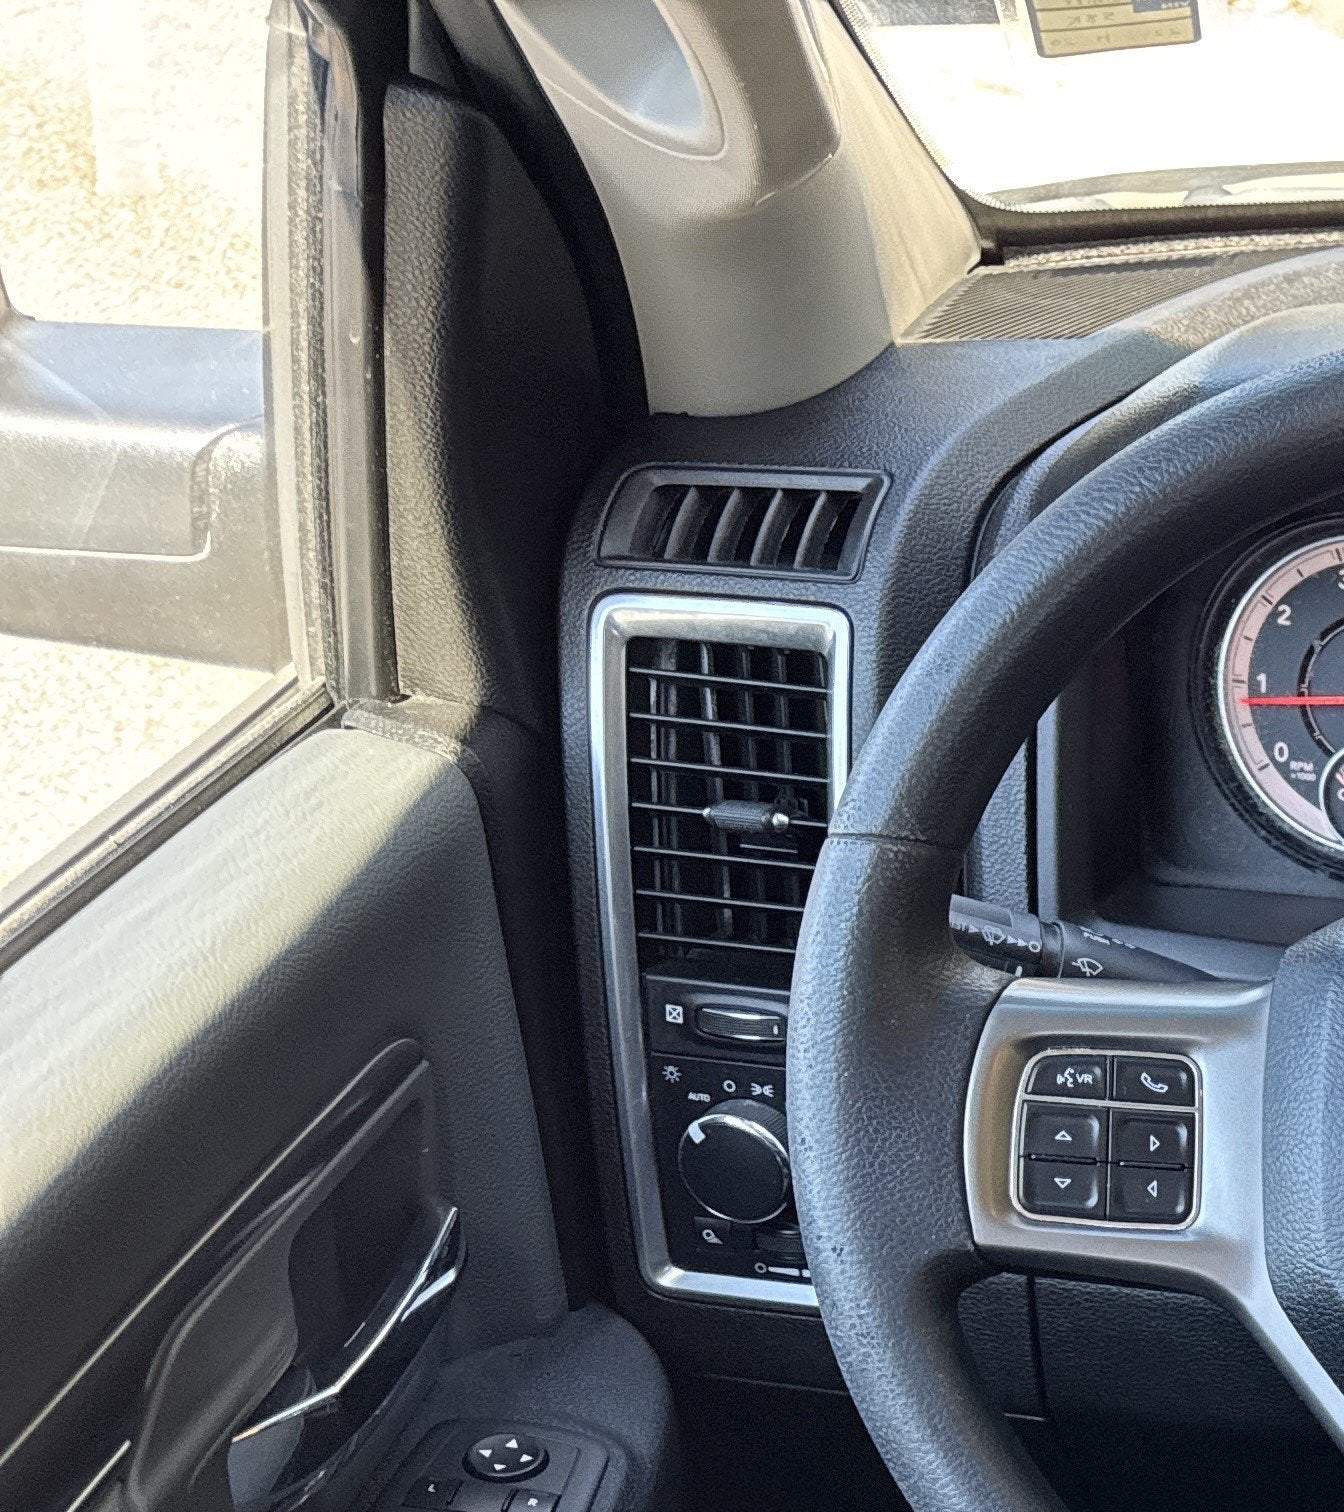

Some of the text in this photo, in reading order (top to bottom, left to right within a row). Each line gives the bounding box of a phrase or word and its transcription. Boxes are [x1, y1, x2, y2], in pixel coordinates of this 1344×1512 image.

[1277, 605, 1291, 626] 2
[1256, 673, 1267, 693] 1
[1274, 742, 1289, 762] 0
[1290, 760, 1314, 772] RPM
[1076, 1073, 1093, 1085] VR
[688, 1091, 711, 1103] AUTO
[527, 1497, 539, 1507] R
